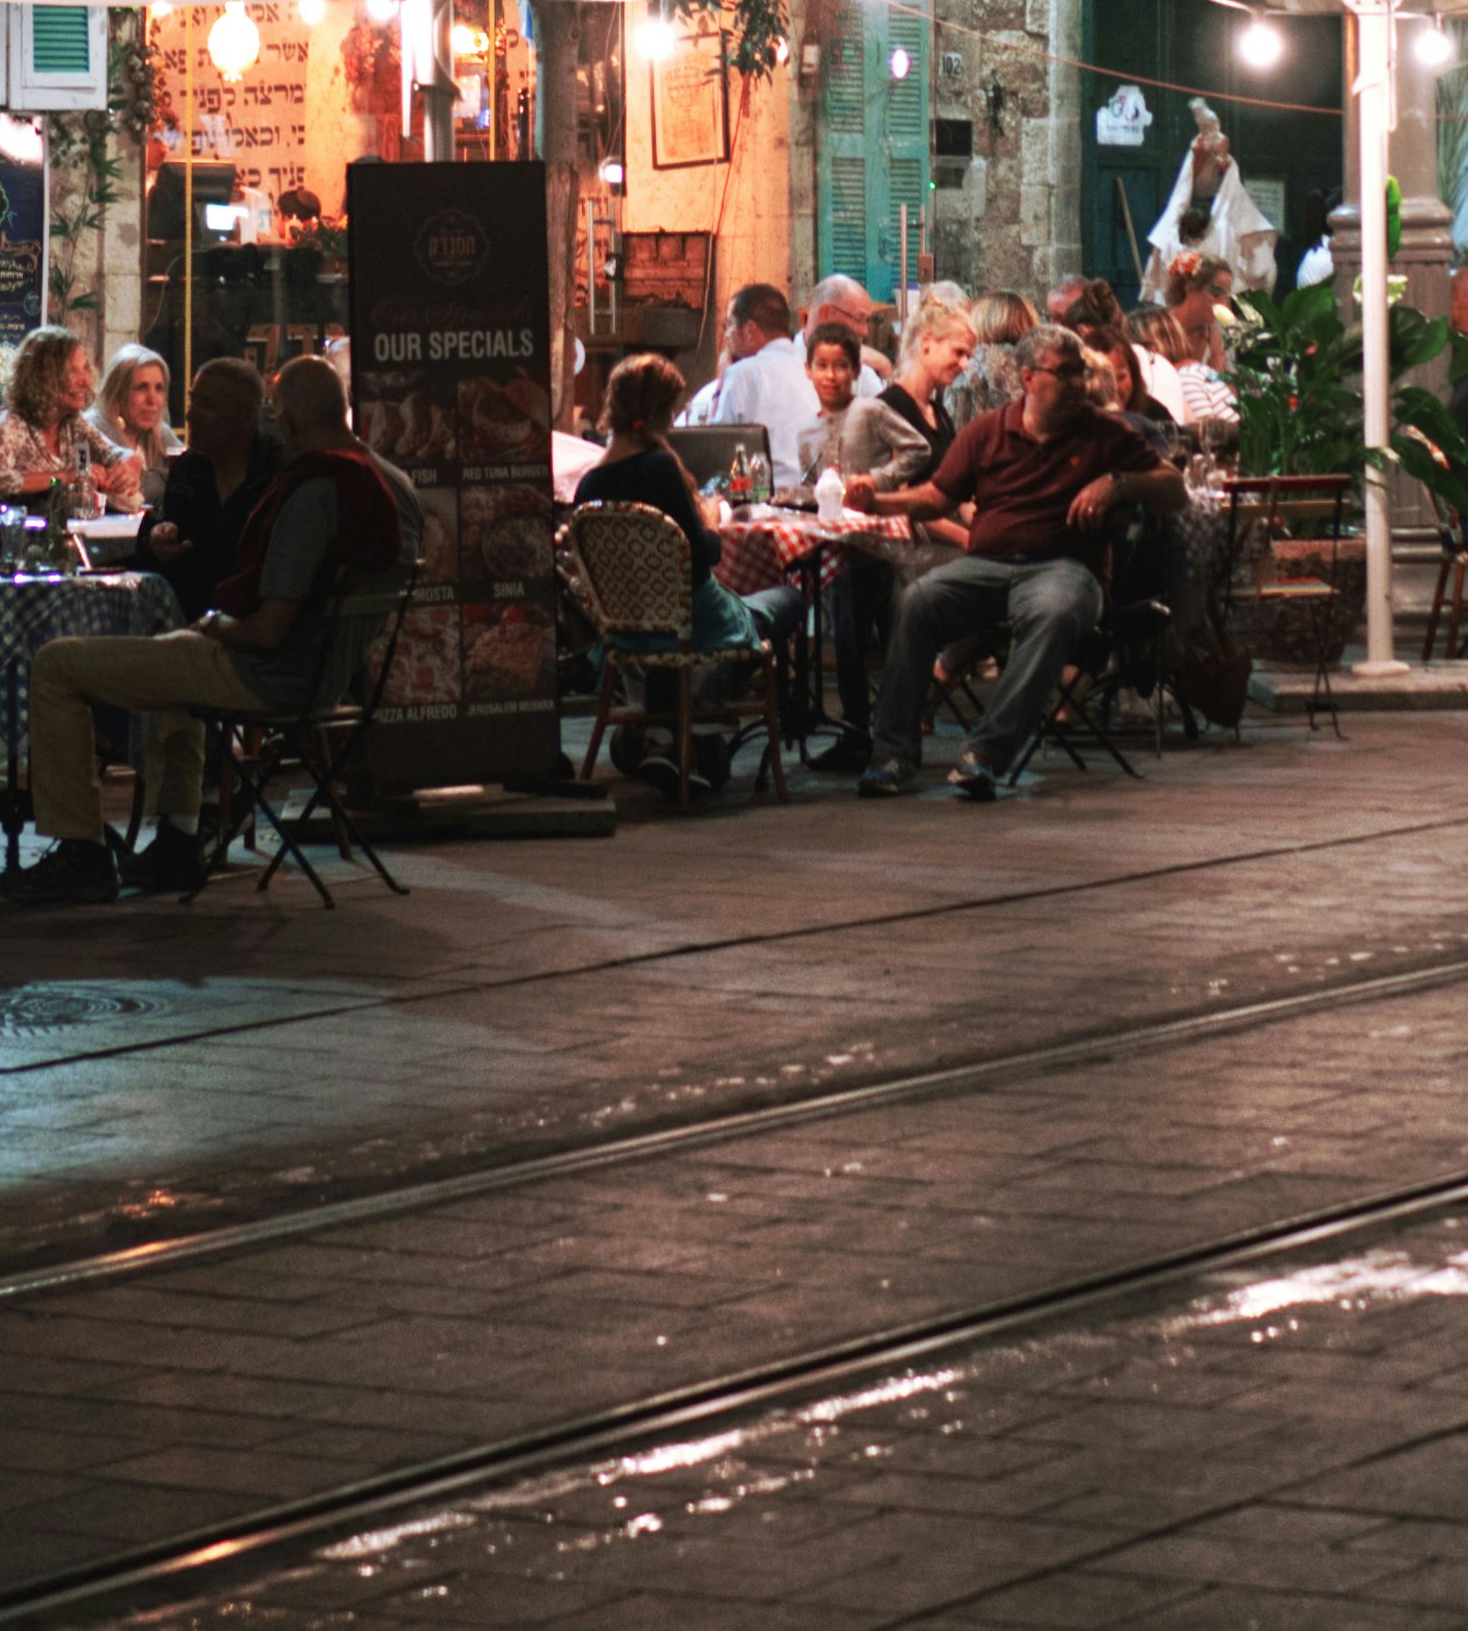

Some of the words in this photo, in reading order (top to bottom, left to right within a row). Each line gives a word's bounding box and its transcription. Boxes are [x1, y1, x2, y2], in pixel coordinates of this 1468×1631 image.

[374, 333, 422, 362] OUR
[429, 328, 534, 360] SPECIALS
[462, 467, 482, 480] RED
[484, 466, 508, 479] TUNA
[493, 581, 524, 598] SINIA
[406, 704, 457, 722] ALFREDO
